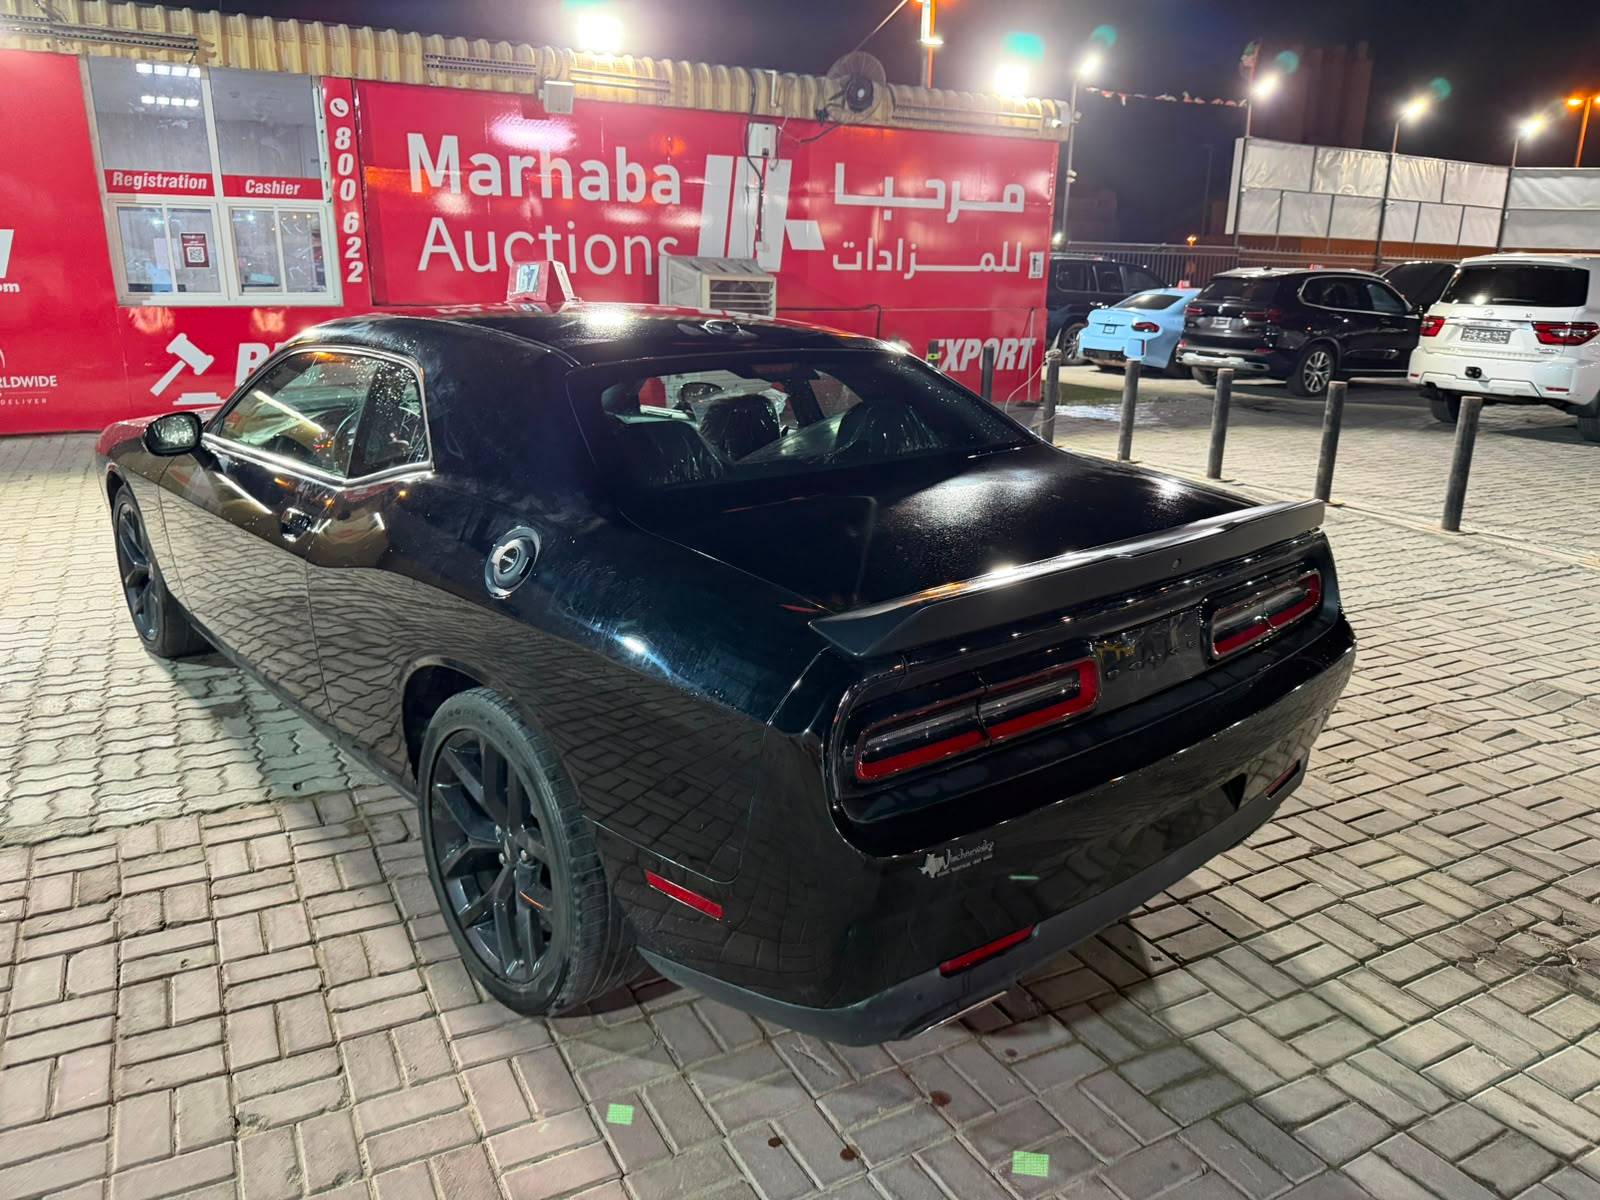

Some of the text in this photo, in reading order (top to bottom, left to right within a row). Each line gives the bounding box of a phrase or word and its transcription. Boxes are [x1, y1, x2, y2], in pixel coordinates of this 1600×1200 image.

[112, 170, 208, 190] Registration
[245, 179, 301, 195] Cashier
[407, 132, 681, 205] Marhaba
[834, 162, 1025, 223] مرحبا
[334, 127, 364, 283] 800 622
[832, 237, 1022, 280] للمزادات
